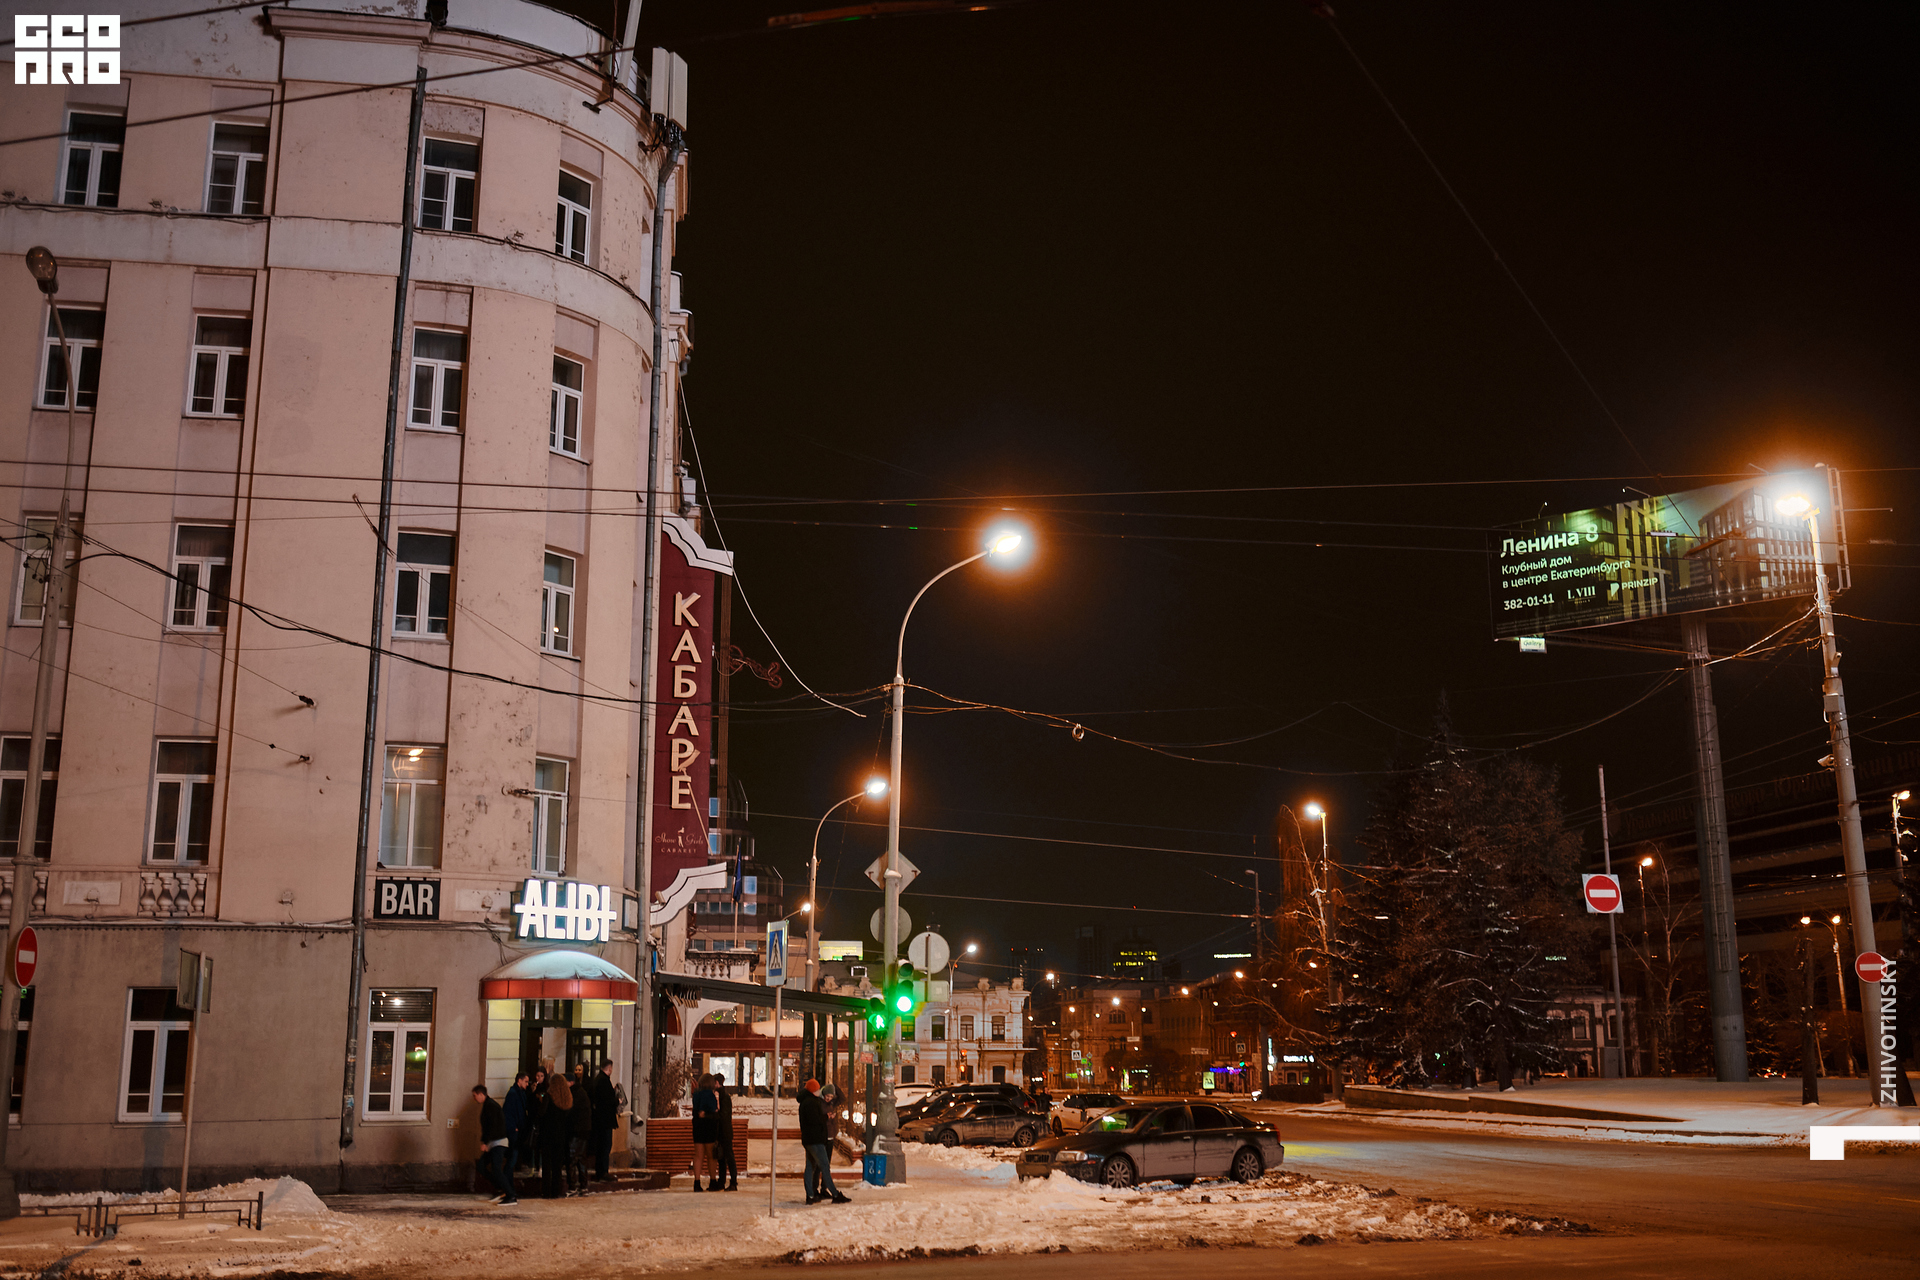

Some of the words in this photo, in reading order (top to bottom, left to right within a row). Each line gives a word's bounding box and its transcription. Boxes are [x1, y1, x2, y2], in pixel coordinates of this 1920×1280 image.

[1500, 531, 1580, 558] Ленина
[1585, 523, 1599, 543] 8
[1501, 558, 1548, 577] Клубный
[1549, 555, 1572, 568] дом
[1502, 581, 1509, 589] в
[1511, 573, 1548, 589] центре
[1551, 559, 1631, 581] Екатеринбурга
[1621, 577, 1658, 591] PRINZIP
[1503, 593, 1555, 611] 382-01-11
[667, 591, 702, 810] КАБАРЕ
[380, 882, 434, 917] BAR
[516, 879, 614, 942] ALIBI
